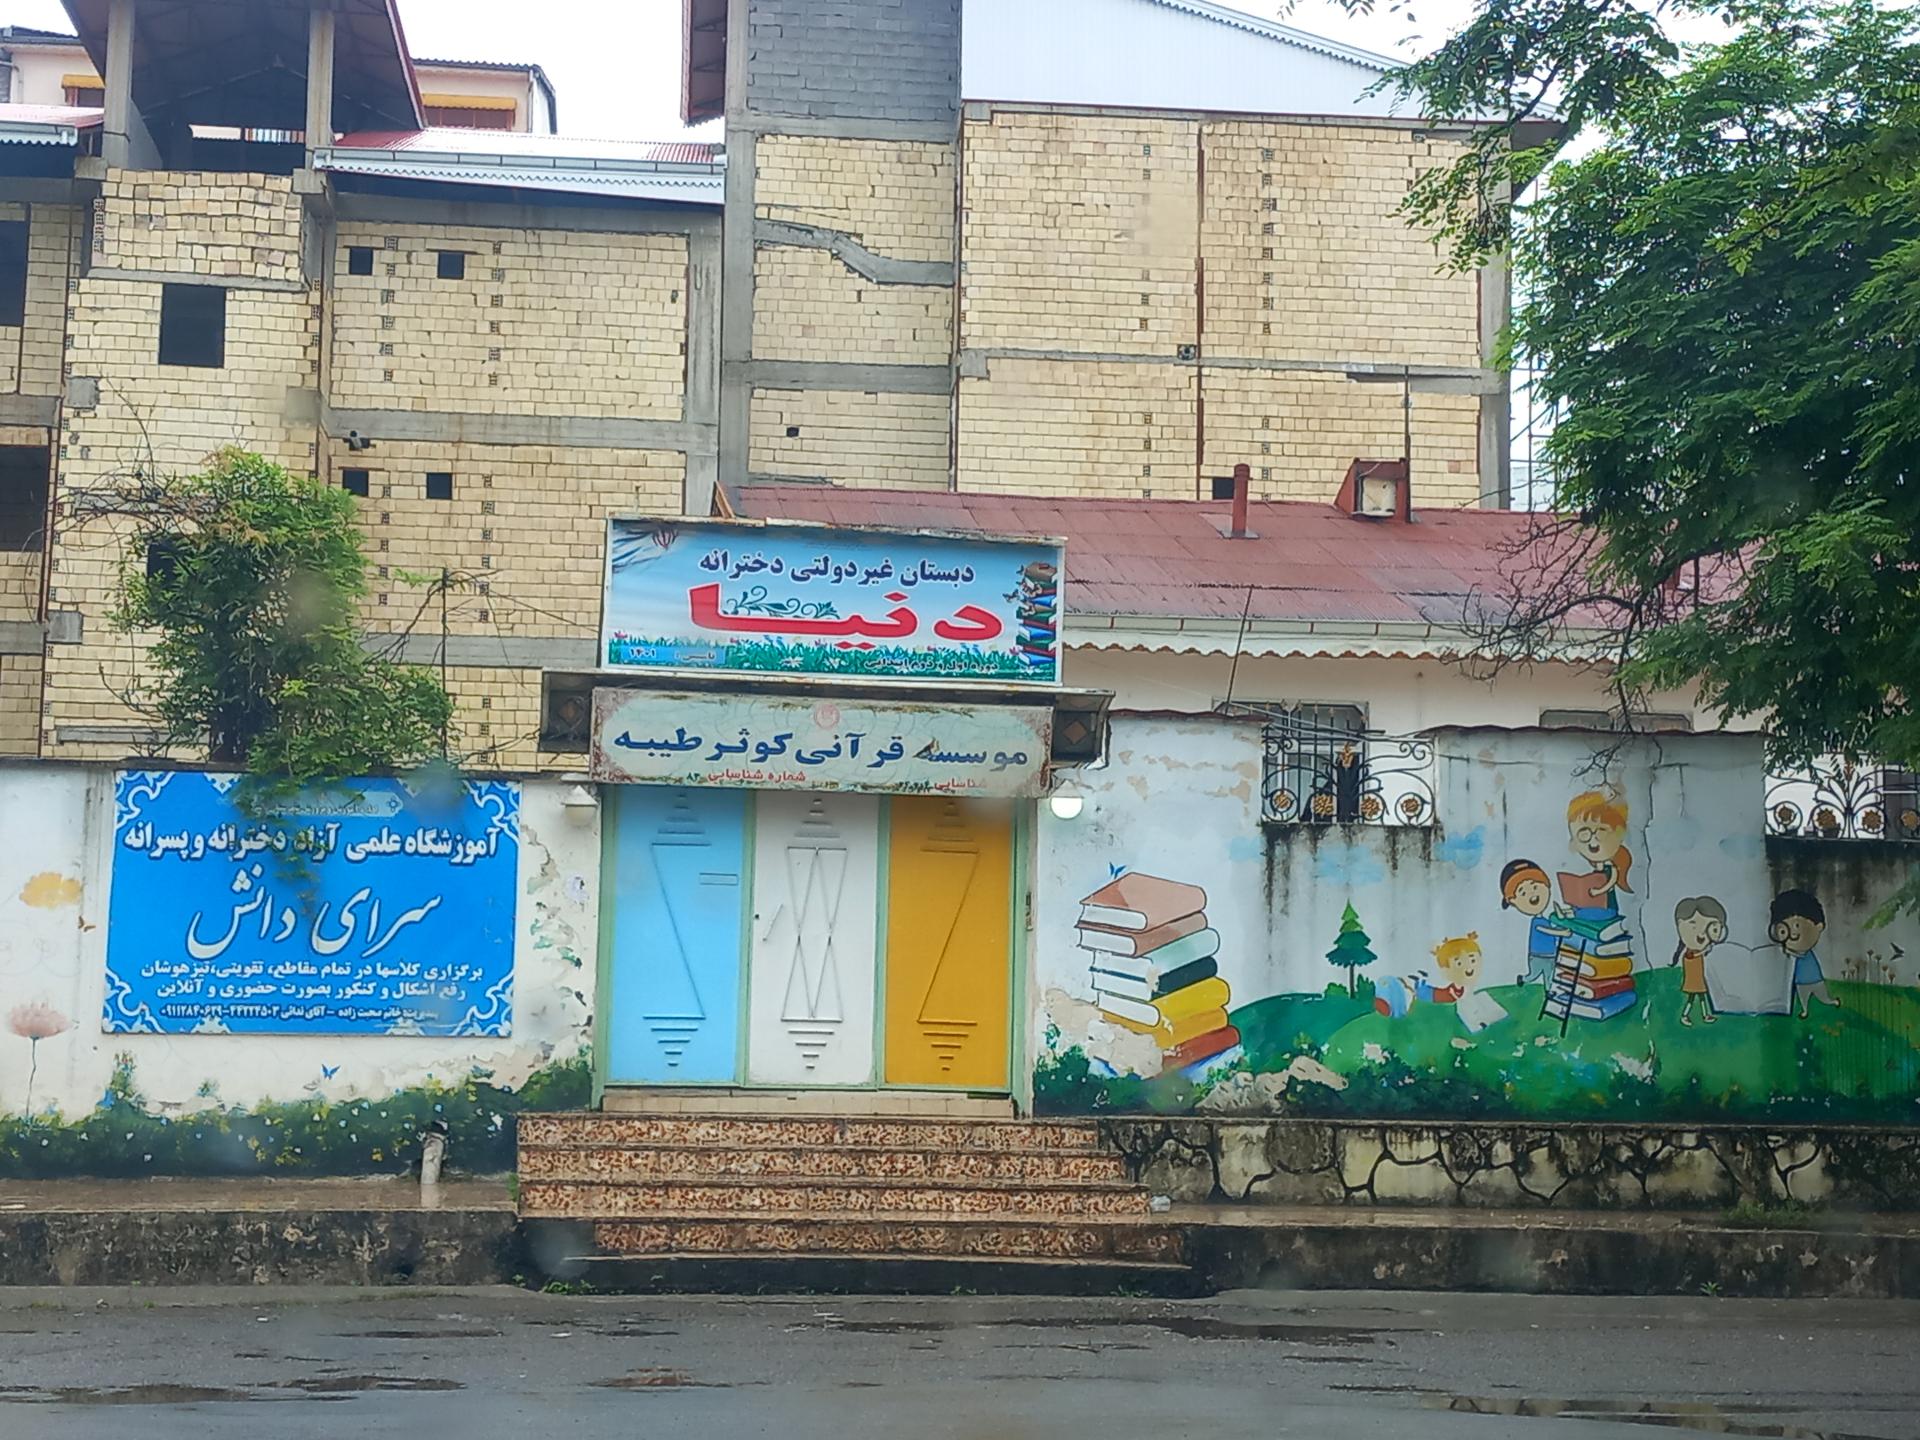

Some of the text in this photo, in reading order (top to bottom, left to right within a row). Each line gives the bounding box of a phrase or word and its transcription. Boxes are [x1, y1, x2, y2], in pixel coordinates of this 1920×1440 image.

[700, 549, 784, 580] دخترانه
[900, 558, 975, 588] دبستان
[689, 583, 1003, 651] دنیا
[613, 727, 703, 758] طیبه
[704, 728, 794, 763] کوثر
[795, 732, 905, 768] قرآنی
[767, 770, 807, 783] شماره
[124, 821, 189, 859] پسرانه
[190, 833, 205, 859] و
[346, 826, 401, 861] علمی
[404, 826, 500, 864] آموزشگاه
[187, 863, 442, 960] سرای دانش
[321, 961, 352, 979] تمام
[354, 964, 373, 979] در
[376, 962, 421, 979] کلاسها
[423, 963, 483, 981] برگزاری
[157, 978, 466, 1001] رفع اشکال و کنکور بصورت حضوری و آنلاین
